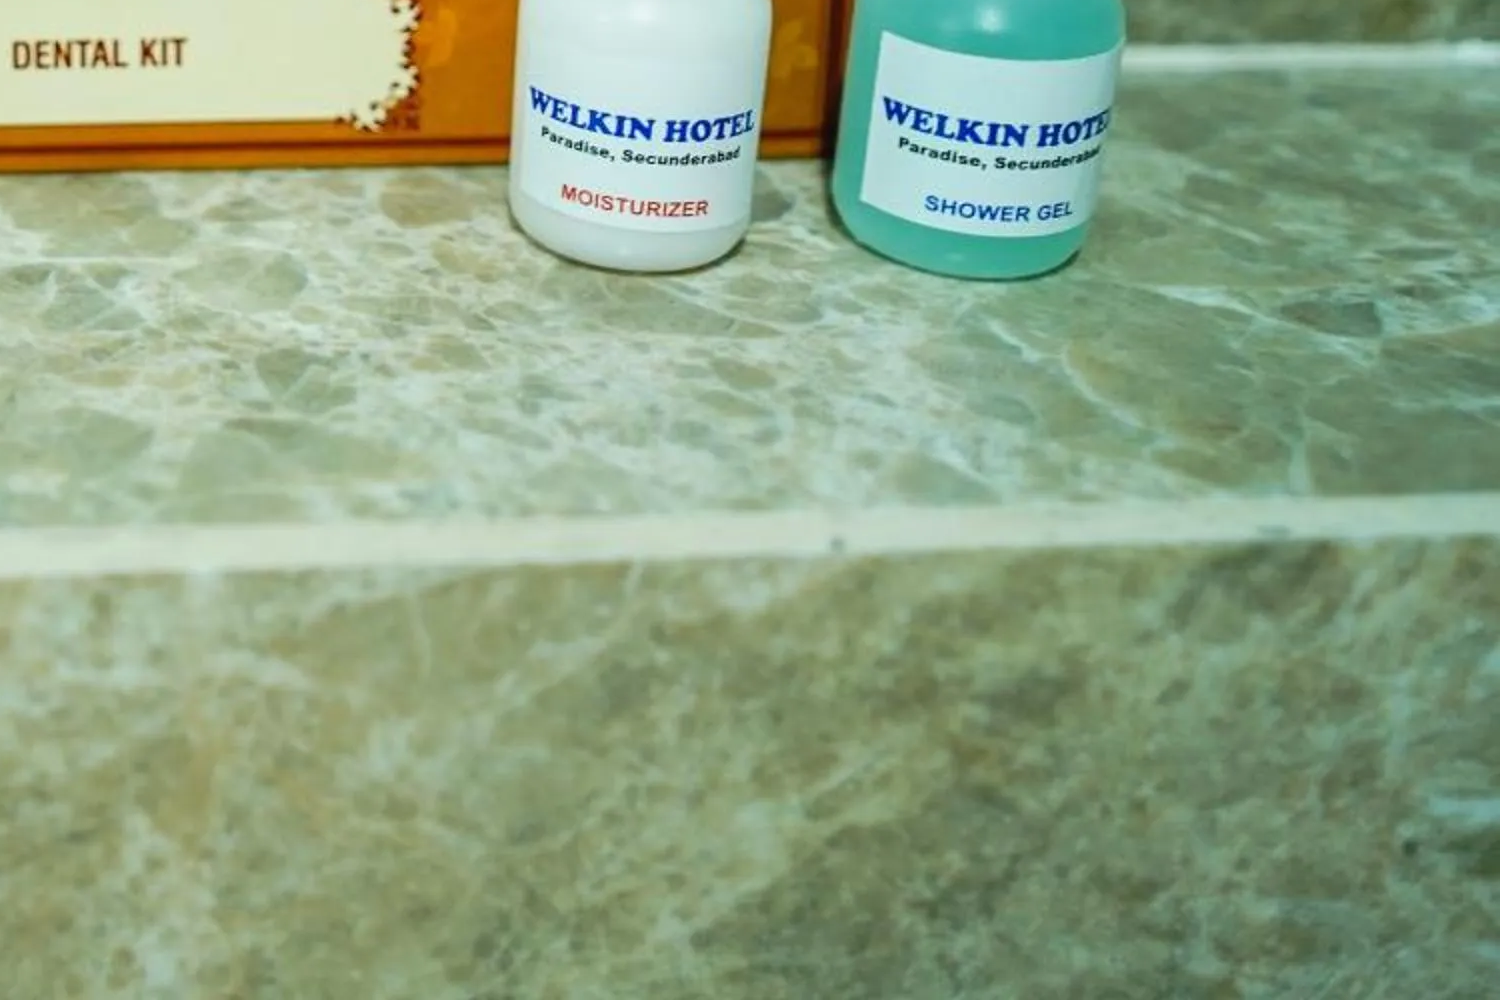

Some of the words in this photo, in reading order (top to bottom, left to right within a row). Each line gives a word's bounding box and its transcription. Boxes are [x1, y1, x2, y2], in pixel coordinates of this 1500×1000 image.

[12, 40, 130, 70] DENTAL
[140, 37, 188, 67] KIT
[529, 85, 655, 141] WELKIN
[663, 109, 755, 143] HOTEL
[882, 96, 1030, 148] WELKIN
[1036, 106, 1112, 147] HOTE
[541, 126, 615, 161] Paradise,
[622, 146, 741, 166] Secunderabad
[899, 137, 987, 171] Paradise,
[561, 183, 710, 217] MOISTURIZER
[924, 195, 1030, 222] SHOWER
[1037, 201, 1074, 221] GEL
